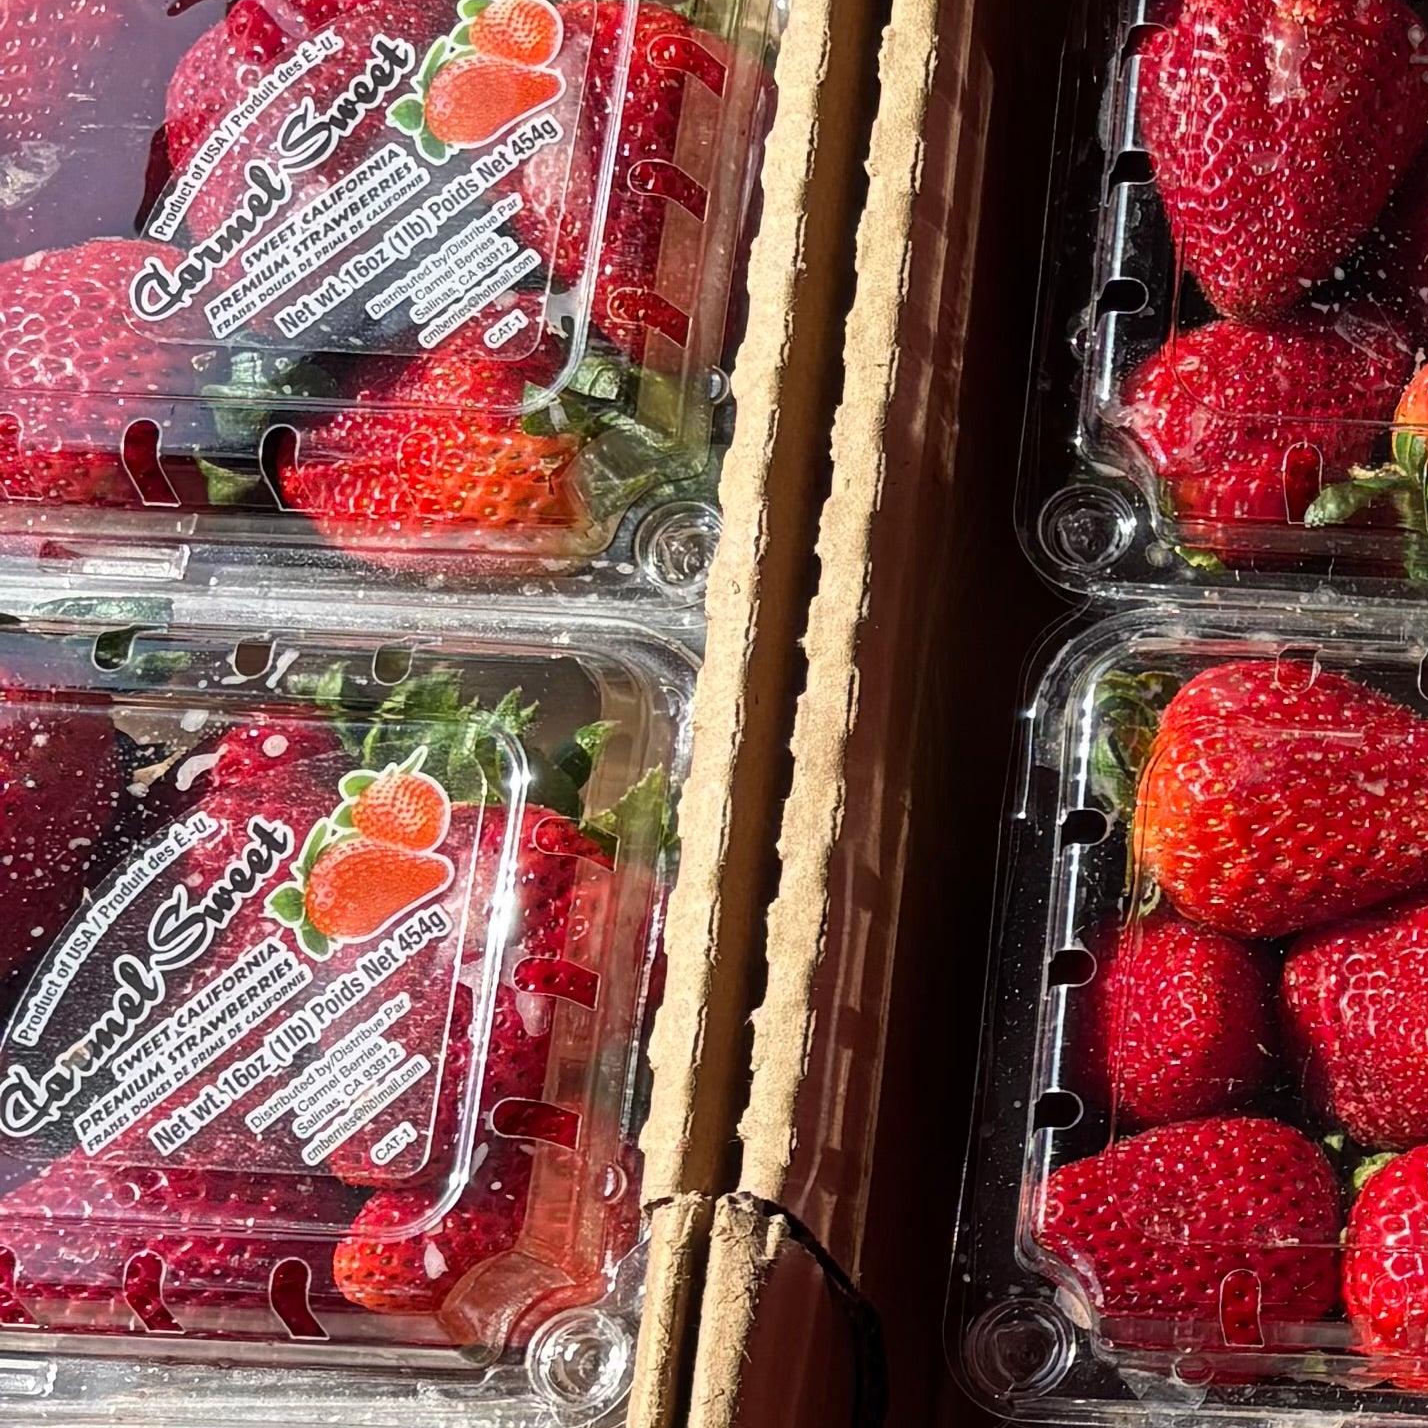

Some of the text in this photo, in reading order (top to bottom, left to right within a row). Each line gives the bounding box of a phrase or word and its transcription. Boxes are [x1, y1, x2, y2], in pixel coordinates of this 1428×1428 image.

[135, 39, 409, 316] Carmel Sweet
[208, 161, 412, 321] PREMIUM STRAWBERRIES
[244, 147, 401, 269] SWEET CALIFORNIA
[0, 821, 288, 1131] Carmel Sweet
[78, 957, 293, 1137] PREMIUM STRAWBERRIES
[116, 942, 281, 1078] SWEET CALIFORNIA
